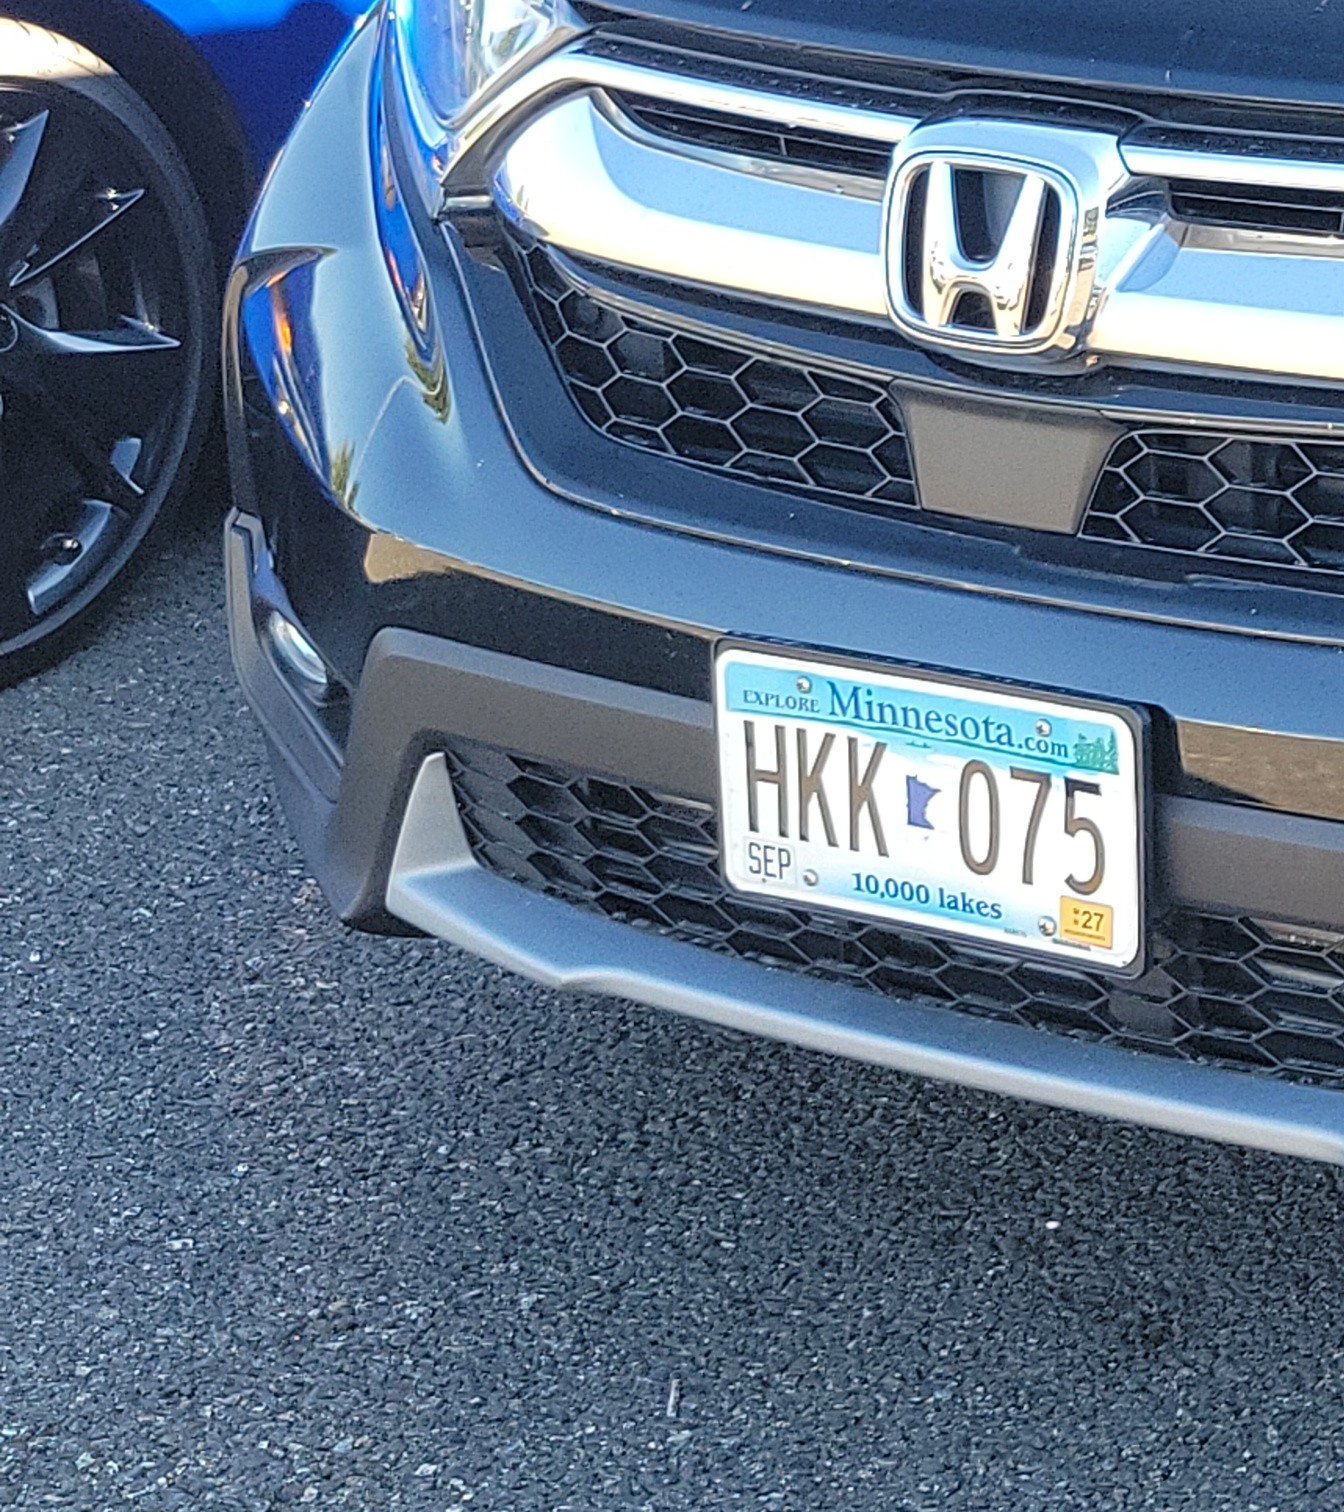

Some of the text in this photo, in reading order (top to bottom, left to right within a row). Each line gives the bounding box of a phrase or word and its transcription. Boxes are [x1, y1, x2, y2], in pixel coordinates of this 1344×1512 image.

[743, 681, 1069, 758] EXPLORE Minnesota.com
[743, 720, 1105, 895] HKK 075
[749, 841, 791, 879] SEP
[851, 872, 1002, 919] 10,000 lakes
